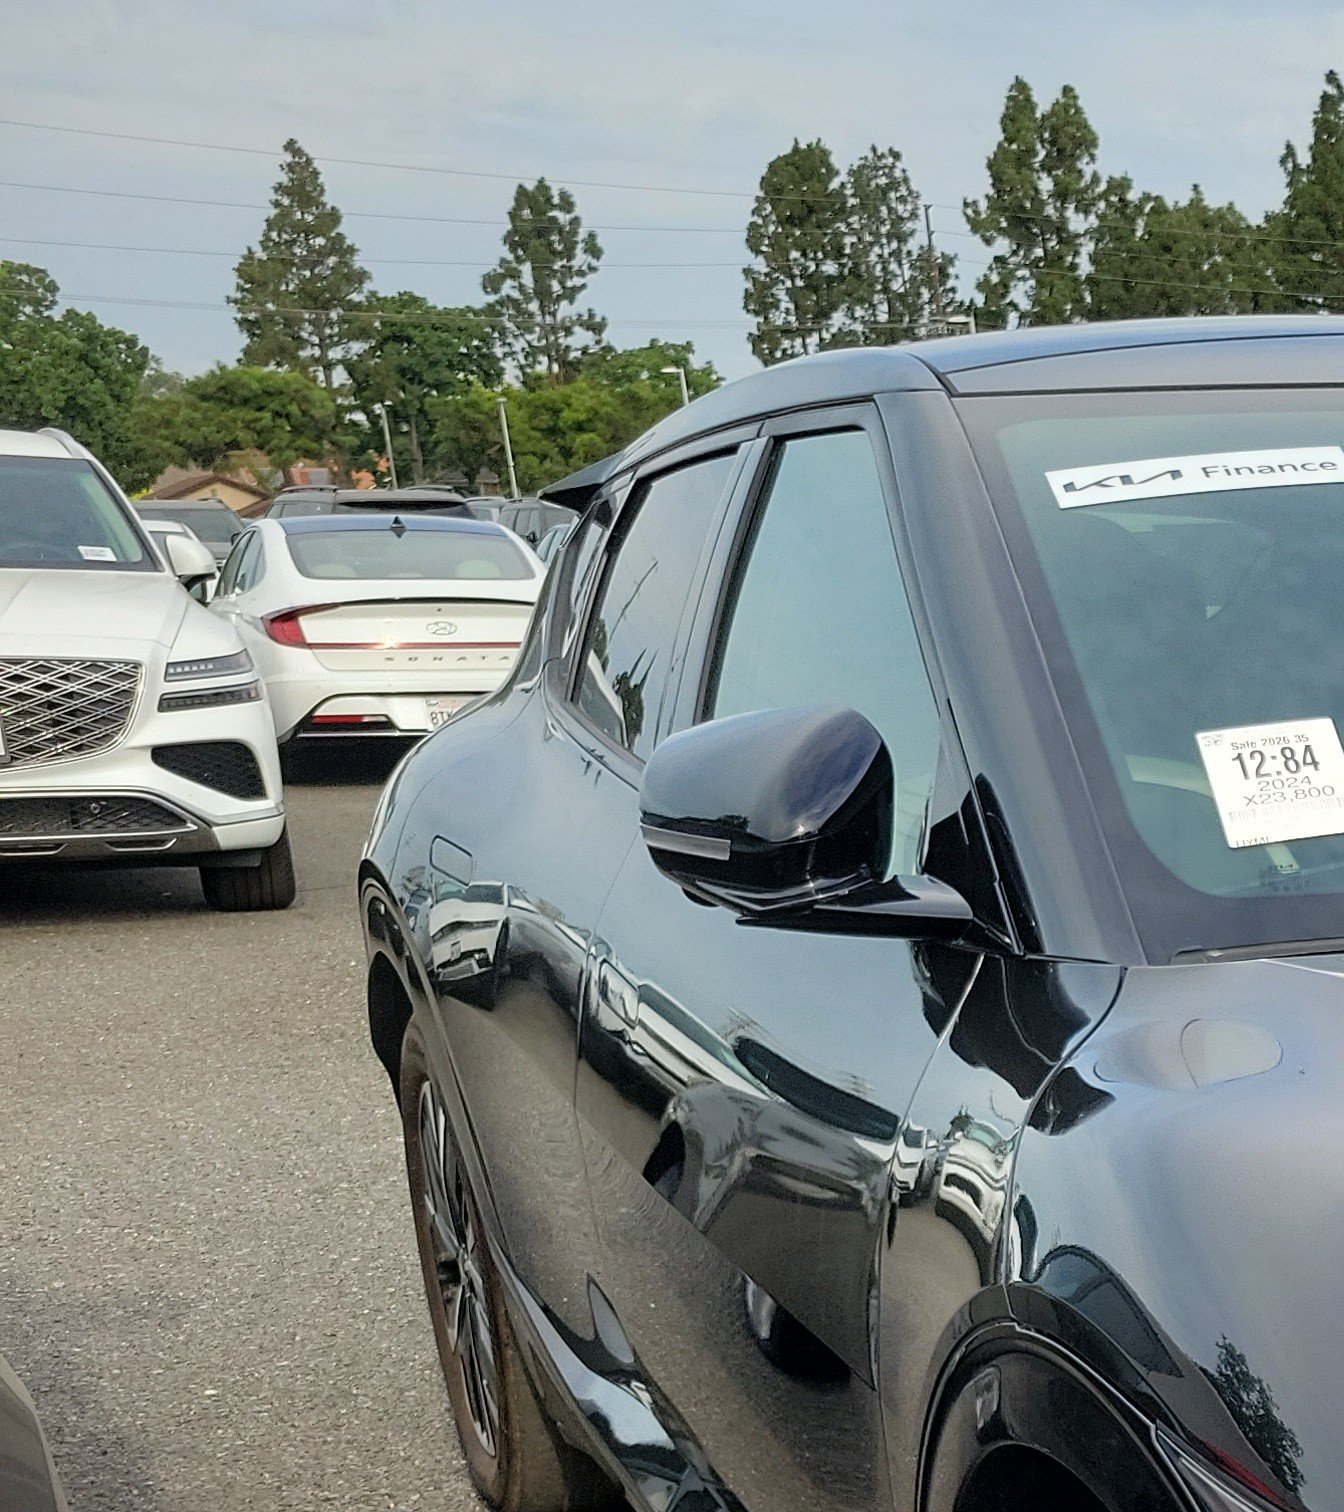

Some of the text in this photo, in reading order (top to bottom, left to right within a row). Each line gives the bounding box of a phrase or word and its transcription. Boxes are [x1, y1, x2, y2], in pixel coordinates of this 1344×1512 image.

[1062, 458, 1339, 493] KIA Finance
[1231, 741, 1257, 751] Sale
[1231, 744, 1320, 781] 12:84
[1257, 775, 1312, 792] 2024
[1243, 785, 1335, 807] X23,800
